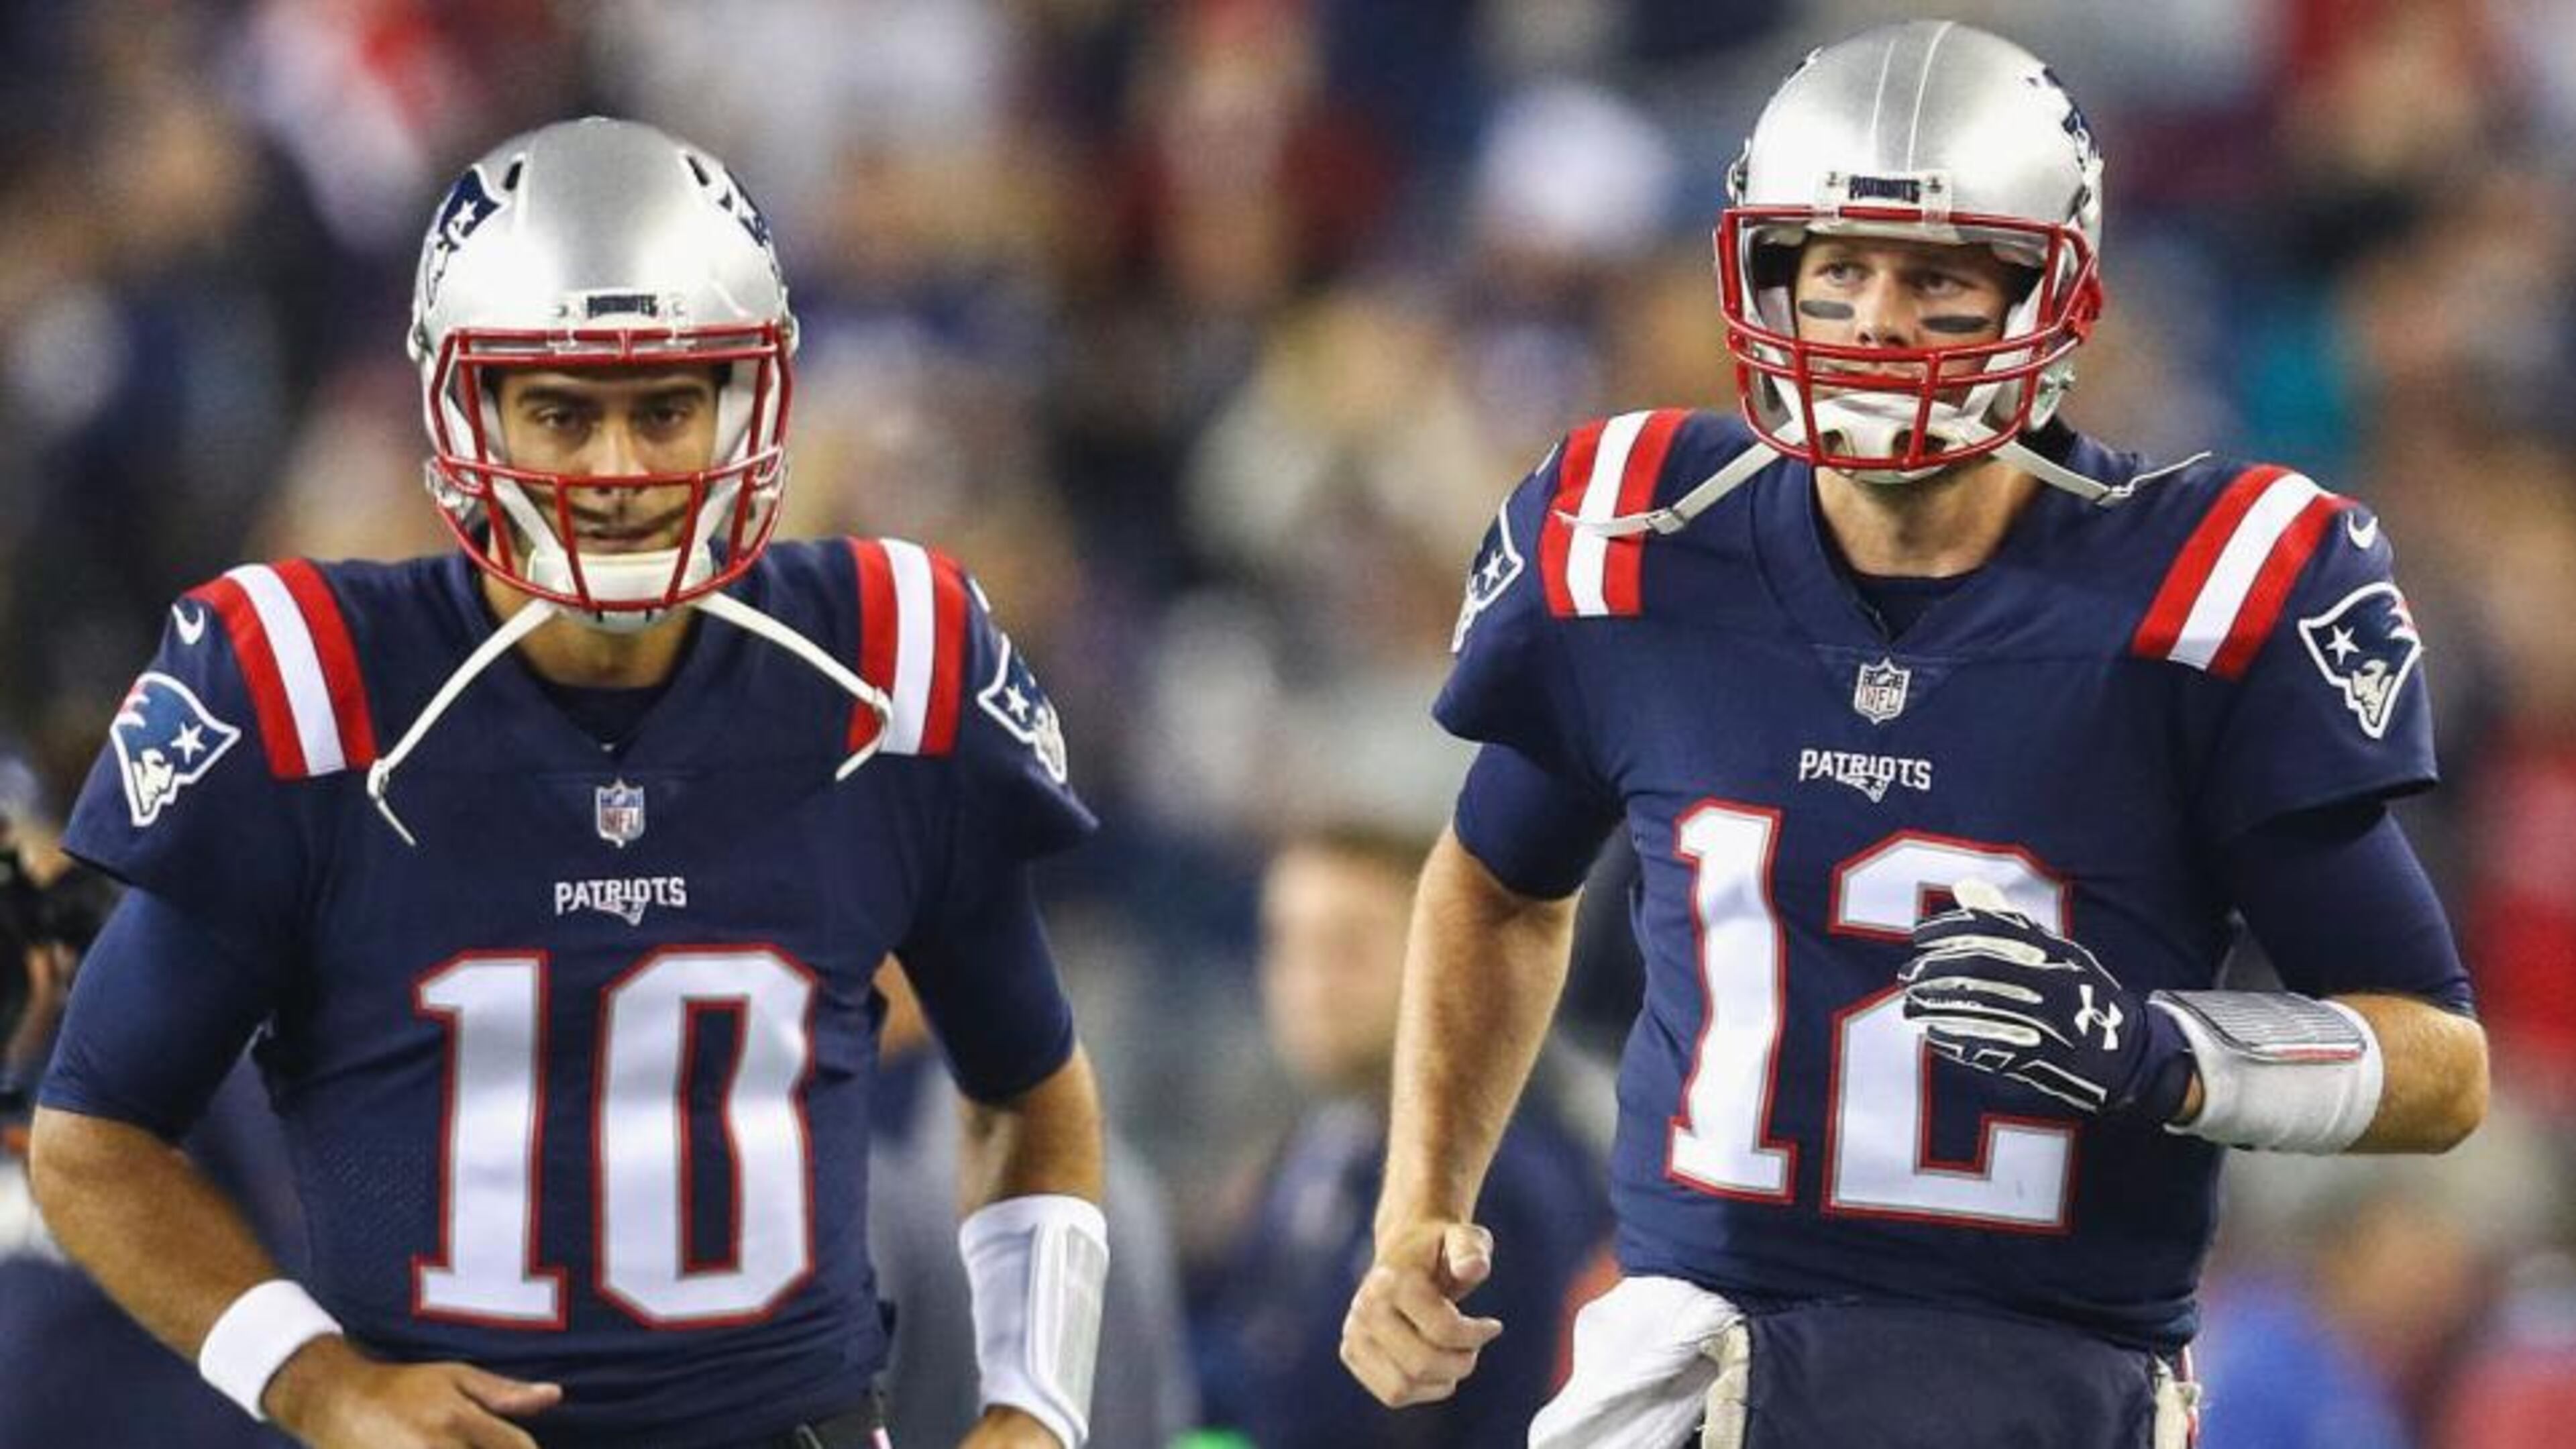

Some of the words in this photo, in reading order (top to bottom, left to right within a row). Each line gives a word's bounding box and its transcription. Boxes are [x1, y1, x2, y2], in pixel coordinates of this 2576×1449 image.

[1859, 686, 1900, 712] NFL
[1798, 748, 1933, 791] PATRIOTS
[555, 877, 688, 916] PATRIOTS
[1665, 797, 2077, 1234] 12
[411, 943, 816, 1330] 10
